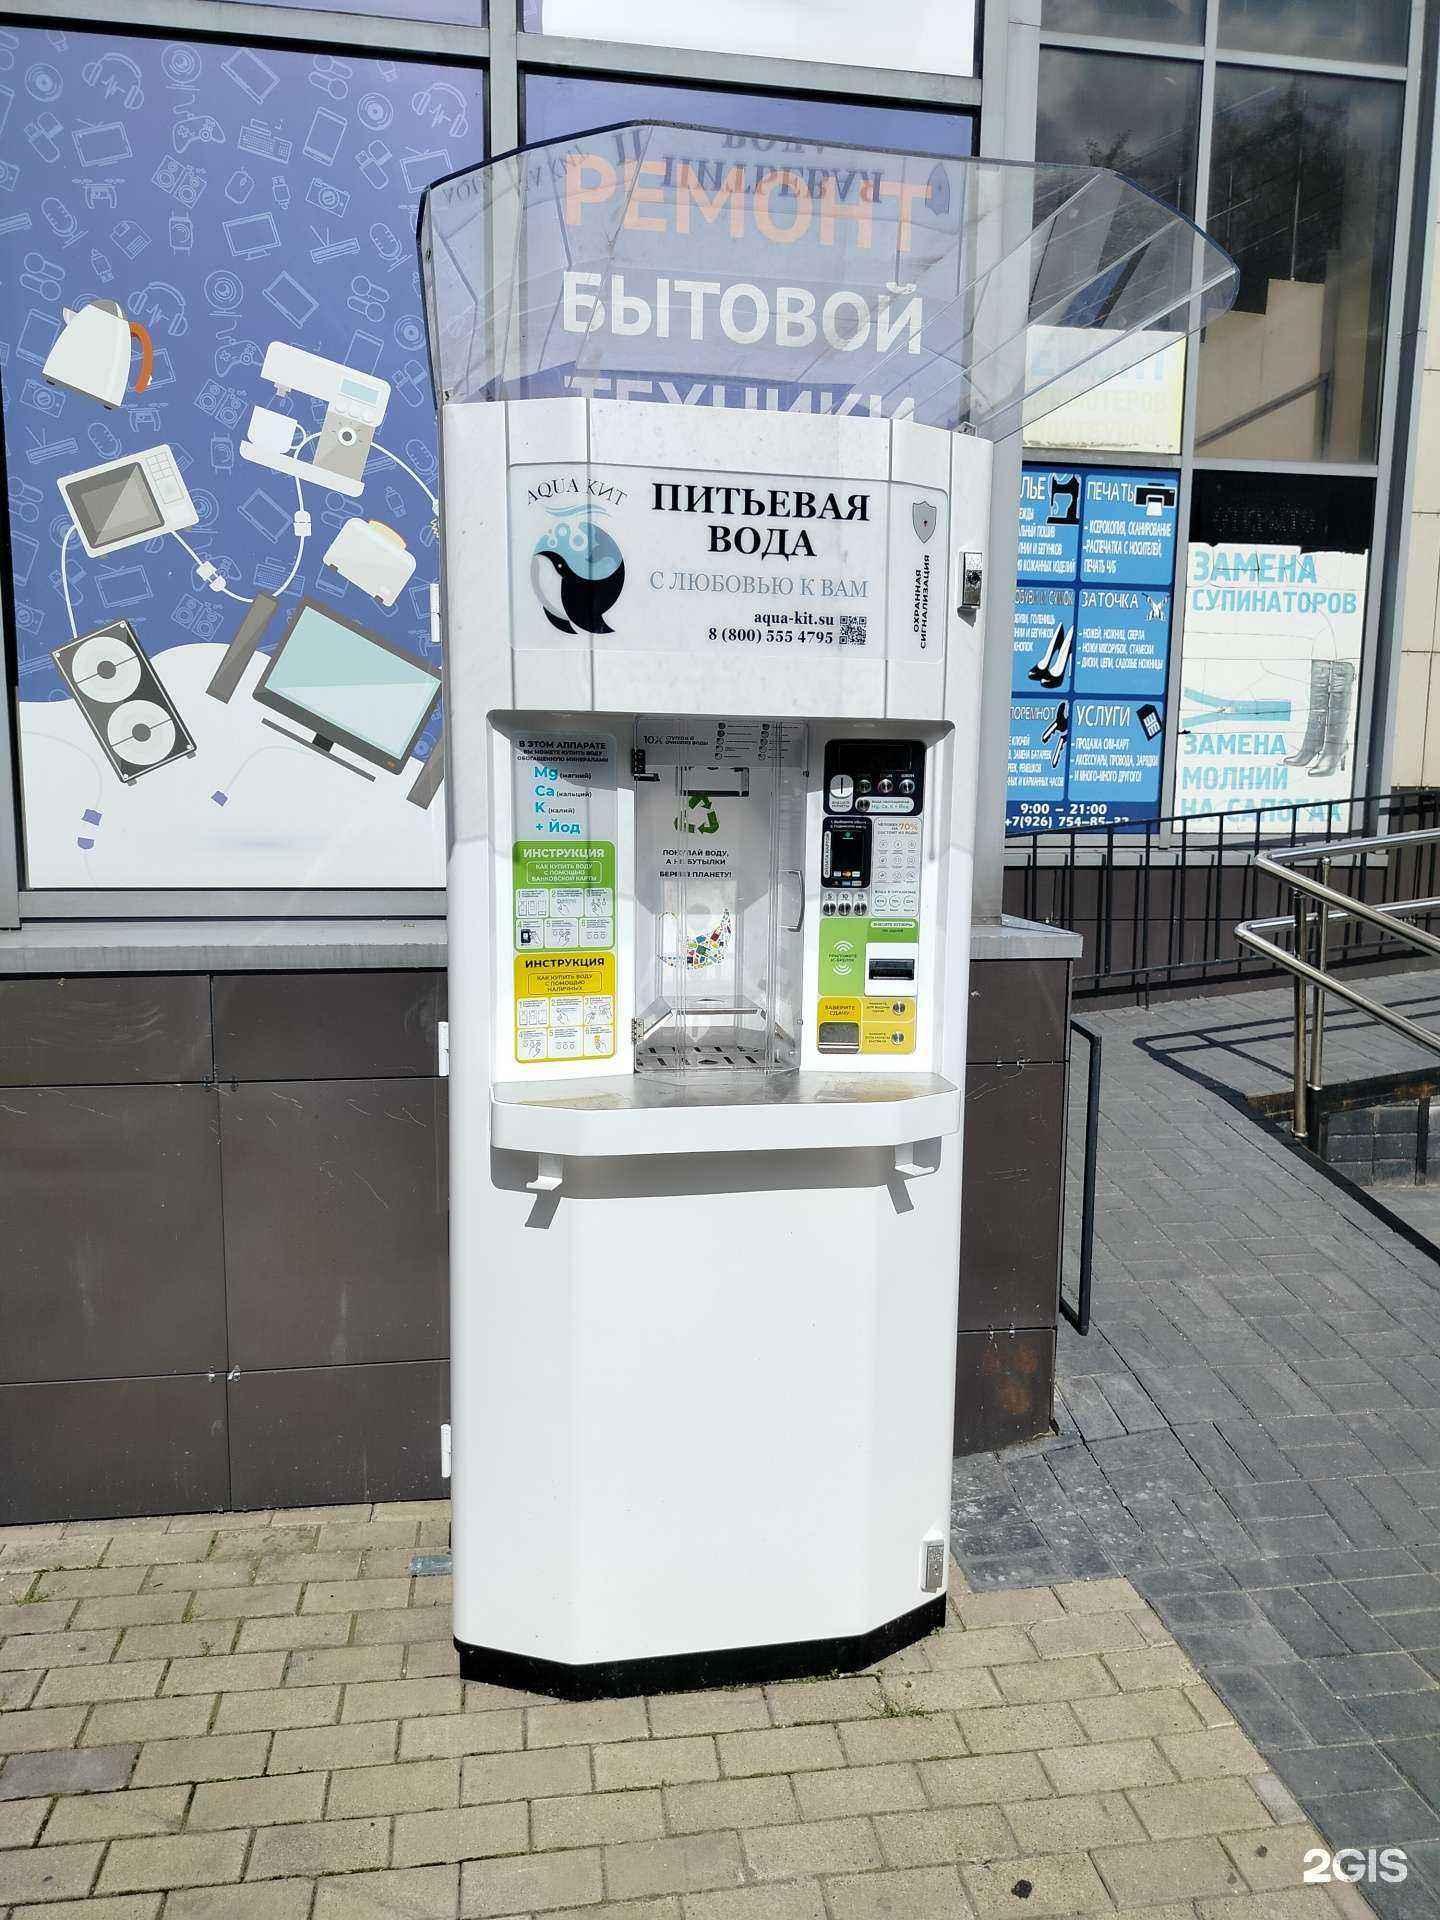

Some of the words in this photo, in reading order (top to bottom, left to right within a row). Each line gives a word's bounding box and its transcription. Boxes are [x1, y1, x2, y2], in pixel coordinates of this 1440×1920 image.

[564, 154, 932, 253] РЕМОНТ
[563, 271, 923, 355] БЫТОВОЙ
[528, 478, 580, 506] AQUA
[586, 478, 628, 507] КИТ
[1087, 481, 1134, 501] ПЕЧАТЬ
[651, 483, 871, 521] ПИТЬЕВАЯ
[707, 525, 817, 562] ВОДА
[1084, 559, 1105, 573] ПЕЧАТЬ
[1193, 550, 1317, 584] ЗАМЕНА
[649, 570, 665, 591] С
[669, 572, 793, 597] ЛЮБОВЬЮ
[799, 578, 816, 597] К
[821, 579, 868, 599] ВАМ
[913, 569, 922, 633] ОХРАННАЯ
[920, 554, 931, 649] СИГНАЛИЗАЦИЯ
[1082, 592, 1138, 608] ЗАТОЧКА
[1192, 589, 1357, 614] СУПИНАТОРОВ
[754, 609, 835, 628] aqua-kit.su
[708, 628, 717, 642] 8
[722, 628, 762, 644] (800)
[766, 628, 793, 643] 555
[798, 630, 833, 645] 4795
[1076, 705, 1130, 727] УСЛУГИ
[519, 740, 525, 748] В
[528, 740, 554, 749] ЭТОМ
[556, 741, 606, 750] АППАРАТЕ
[1183, 733, 1286, 755] ЗАМЕНА
[534, 766, 558, 780] Mg
[559, 772, 591, 780] (магний)
[1182, 763, 1288, 790] МОЛНИЙ
[534, 785, 555, 796] Ca
[556, 791, 592, 799] (кальций)
[548, 807, 576, 815] (калий)
[1020, 803, 1049, 814] 9:00
[1069, 804, 1108, 814] 21:00
[1181, 798, 1215, 822] НА
[549, 818, 581, 834] Йод
[1005, 816, 1052, 829] +7(926)
[523, 848, 605, 859] ИНСТРУКЦИЯ
[705, 850, 729, 858] ВОДУ,
[525, 957, 605, 968] ИНСТРУКЦИЯ
